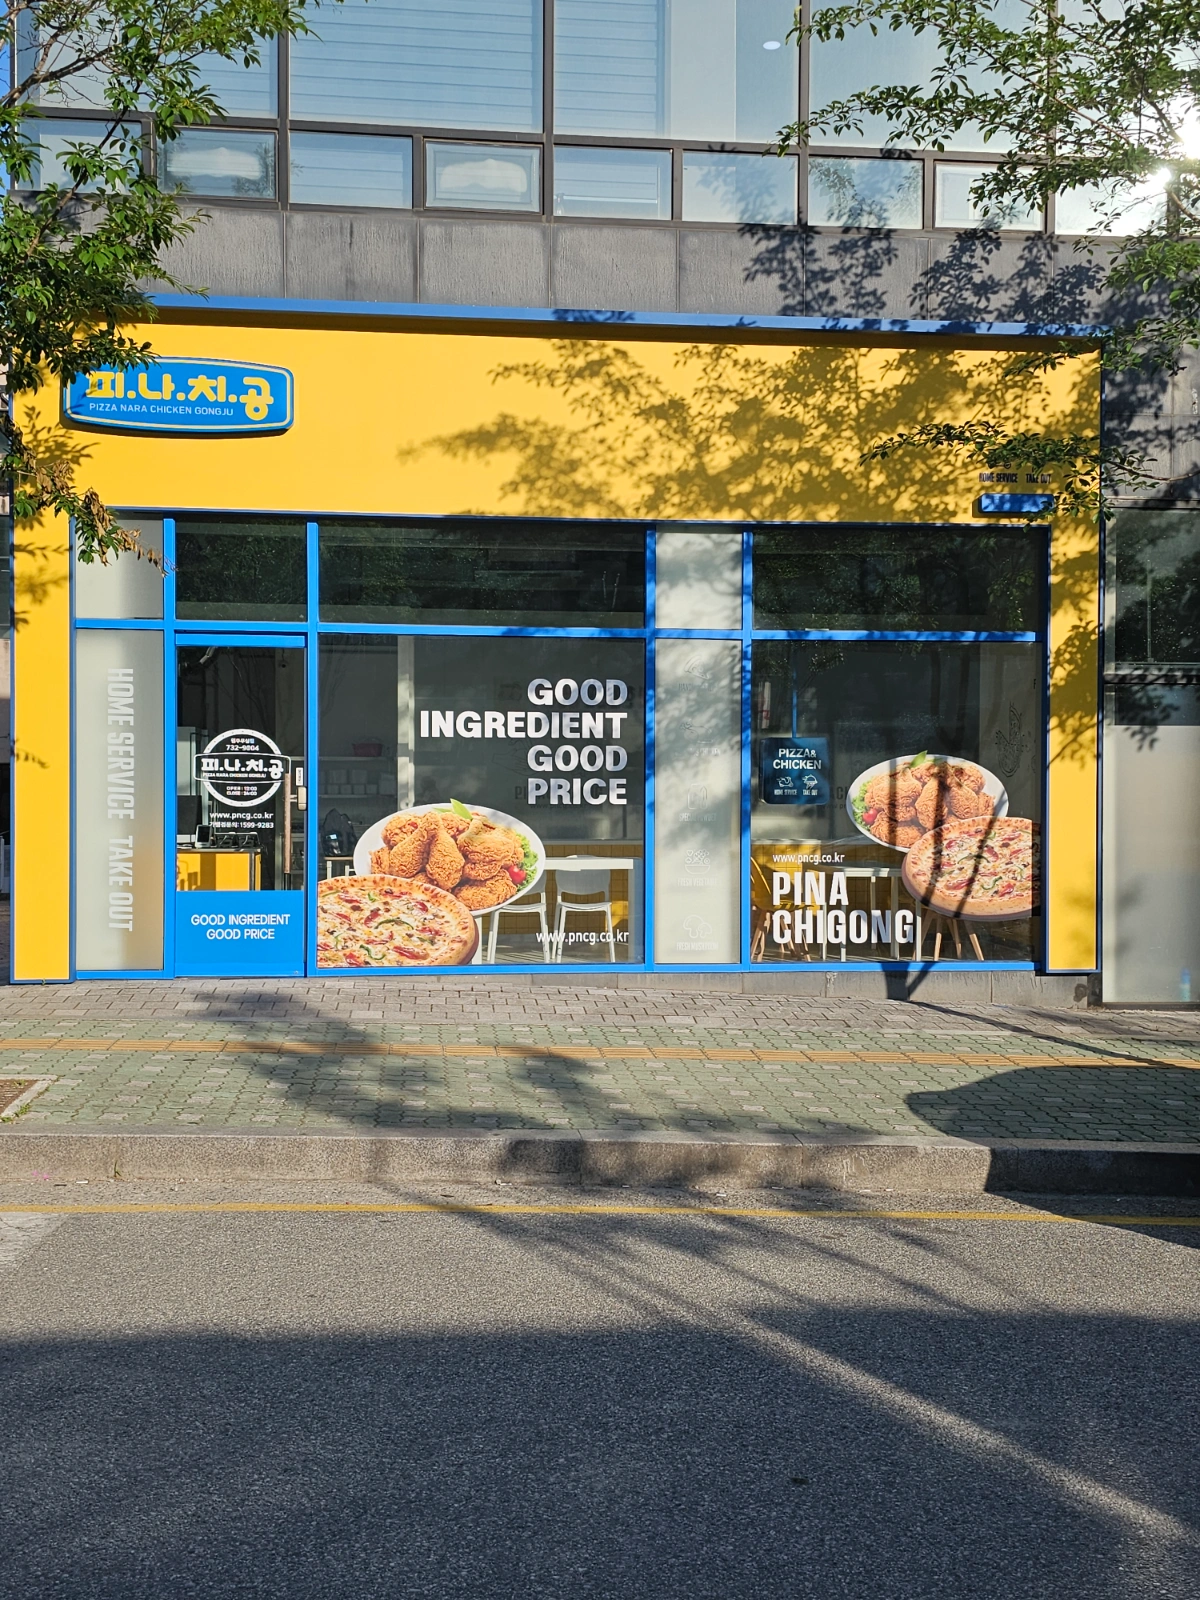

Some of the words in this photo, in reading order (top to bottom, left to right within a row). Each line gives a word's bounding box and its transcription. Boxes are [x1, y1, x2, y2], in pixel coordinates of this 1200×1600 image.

[89, 402, 118, 412] PIZZA
[120, 403, 148, 413] NARA
[150, 405, 191, 415] CHICKEN
[194, 406, 234, 417] GONGJU
[996, 473, 1018, 483] SERVICE
[1040, 473, 1052, 484] OUT
[107, 668, 134, 726] HOME
[527, 678, 628, 706] GOOD
[420, 710, 628, 739] INGREDIENT
[527, 744, 628, 772] GOOD
[772, 759, 822, 770] CHICKEN
[778, 748, 817, 758] PIZZA&
[107, 732, 135, 820] SERVICE
[201, 758, 284, 780] 피.나.치.공
[527, 778, 628, 805] PRICE
[209, 811, 274, 821] www.pncg.co.kr
[108, 835, 133, 887] TAKE
[772, 852, 845, 865] www.pncg.co.kr
[772, 871, 849, 906] PINA
[108, 891, 133, 932] OUT
[190, 914, 226, 926] GOOD
[228, 913, 291, 926] INGREDIENT
[206, 928, 241, 940] GOOD
[243, 928, 275, 940] PRICE
[535, 929, 630, 946] www.pncg.co.kr
[772, 909, 914, 944] CHIGONG
